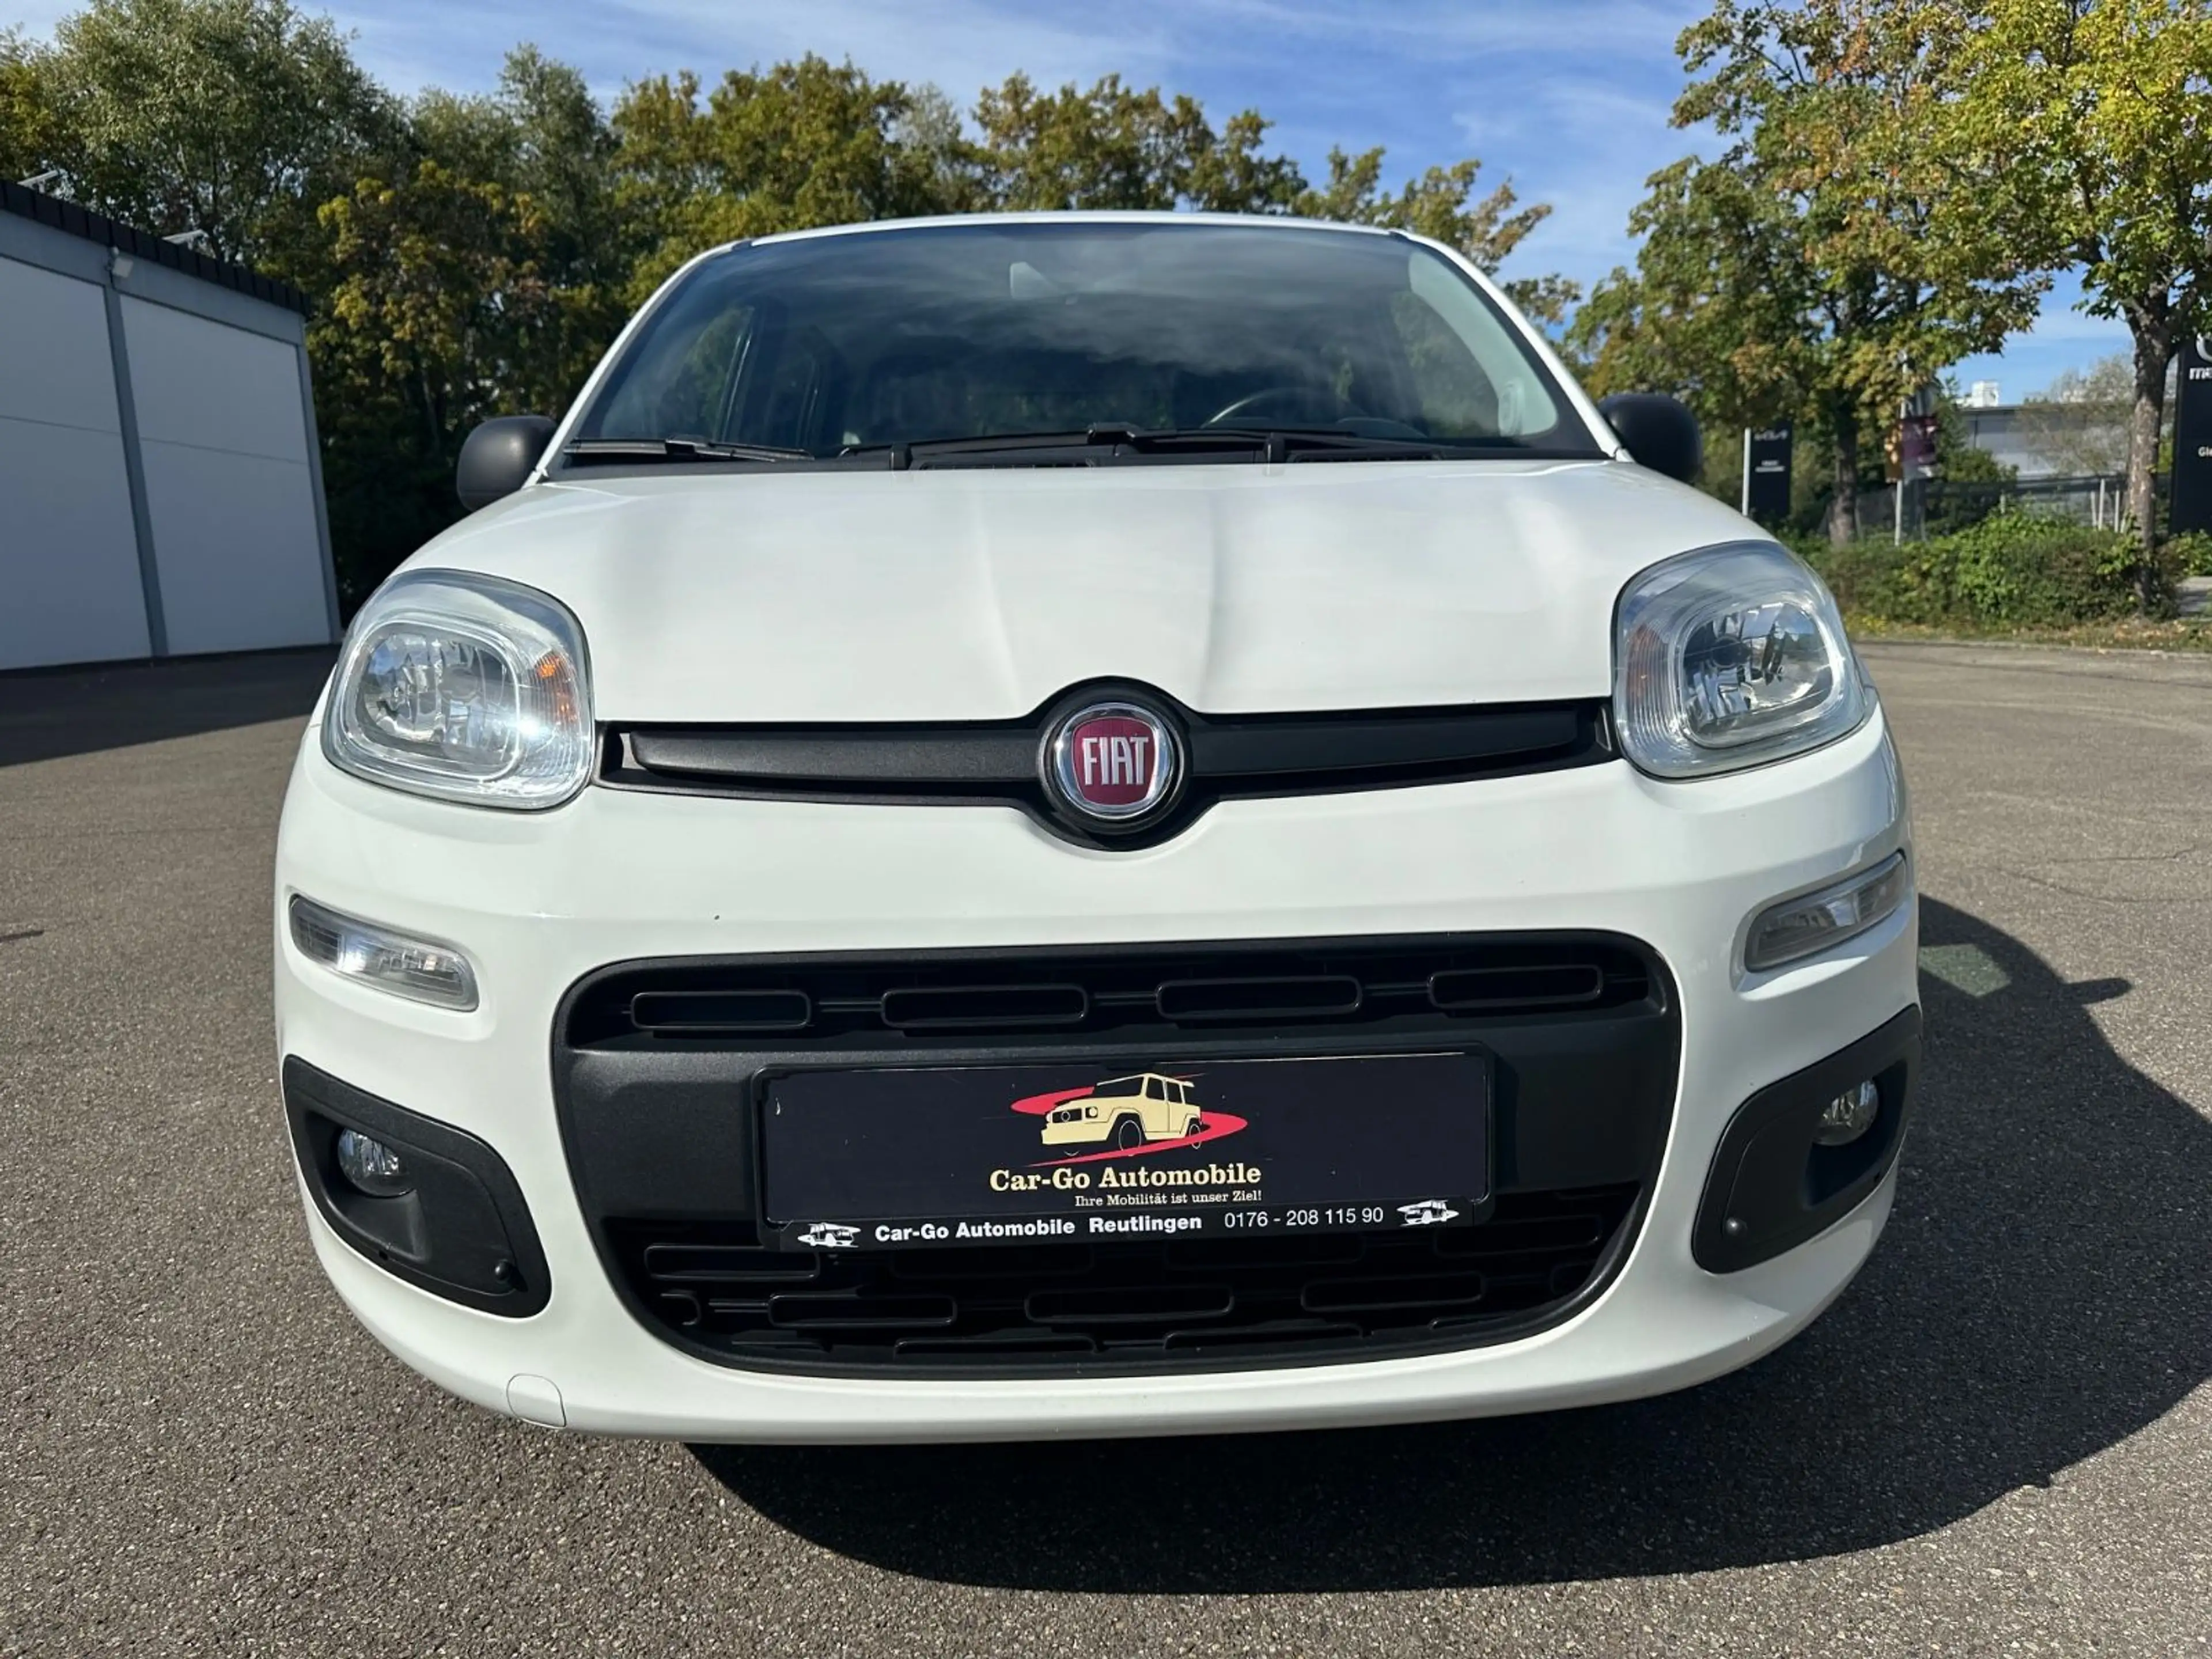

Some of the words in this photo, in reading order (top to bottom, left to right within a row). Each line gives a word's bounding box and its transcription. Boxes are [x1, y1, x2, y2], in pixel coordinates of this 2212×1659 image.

[1082, 737, 1149, 786] FIAT
[989, 1168, 1090, 1191] Car-Go
[1099, 1163, 1262, 1188] Automobile
[1075, 1195, 1103, 1206] Ihre
[1107, 1192, 1168, 1206] Mobilität
[1171, 1193, 1188, 1203] ist
[1192, 1192, 1228, 1203] unser
[1233, 1190, 1262, 1202] Ziel!
[875, 1223, 949, 1242] Car-Go
[955, 1218, 1075, 1238] Automobile
[1089, 1215, 1202, 1234] Reutlingen
[1224, 1211, 1268, 1228] 0176
[1286, 1210, 1319, 1226] 208
[1325, 1209, 1356, 1225] 115
[1361, 1207, 1383, 1223] 90
